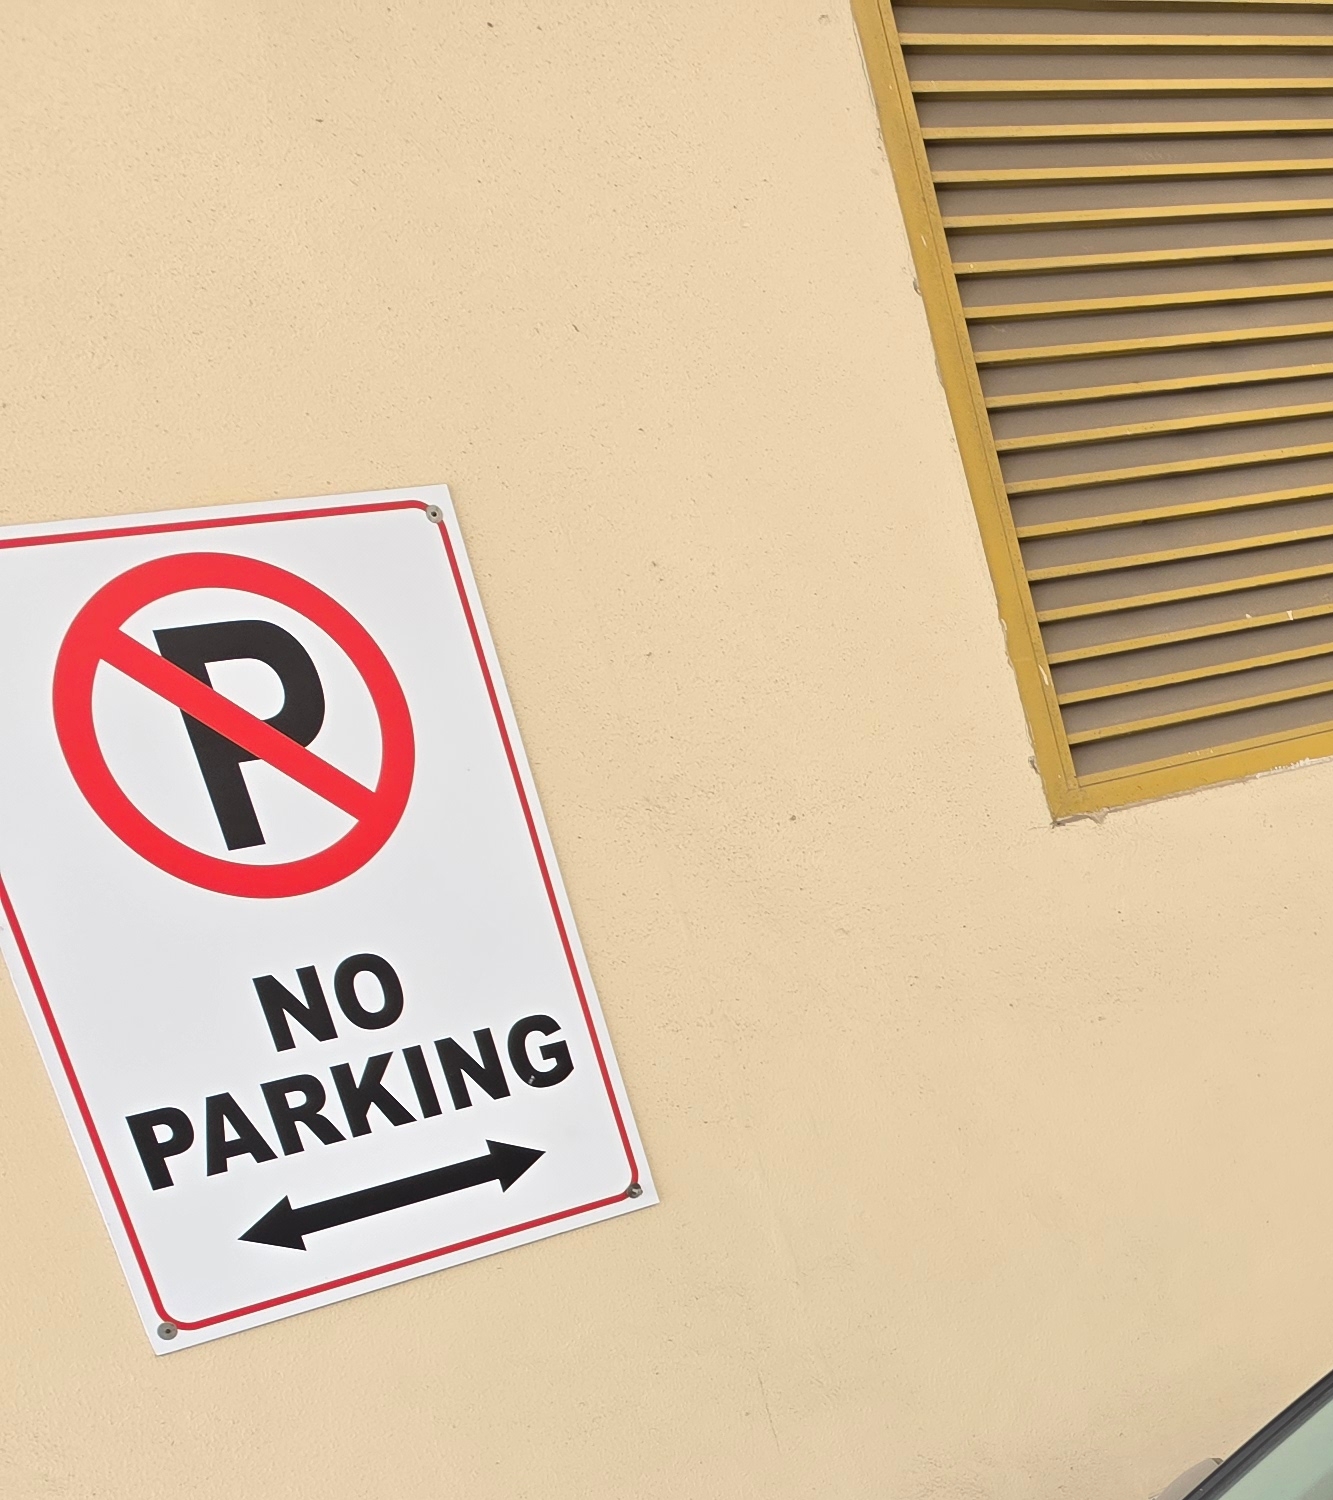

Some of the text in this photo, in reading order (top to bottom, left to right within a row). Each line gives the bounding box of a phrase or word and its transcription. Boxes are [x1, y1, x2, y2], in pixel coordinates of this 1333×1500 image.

[153, 619, 326, 851] P
[252, 953, 405, 1053] NO
[125, 1014, 575, 1191] PARKING
